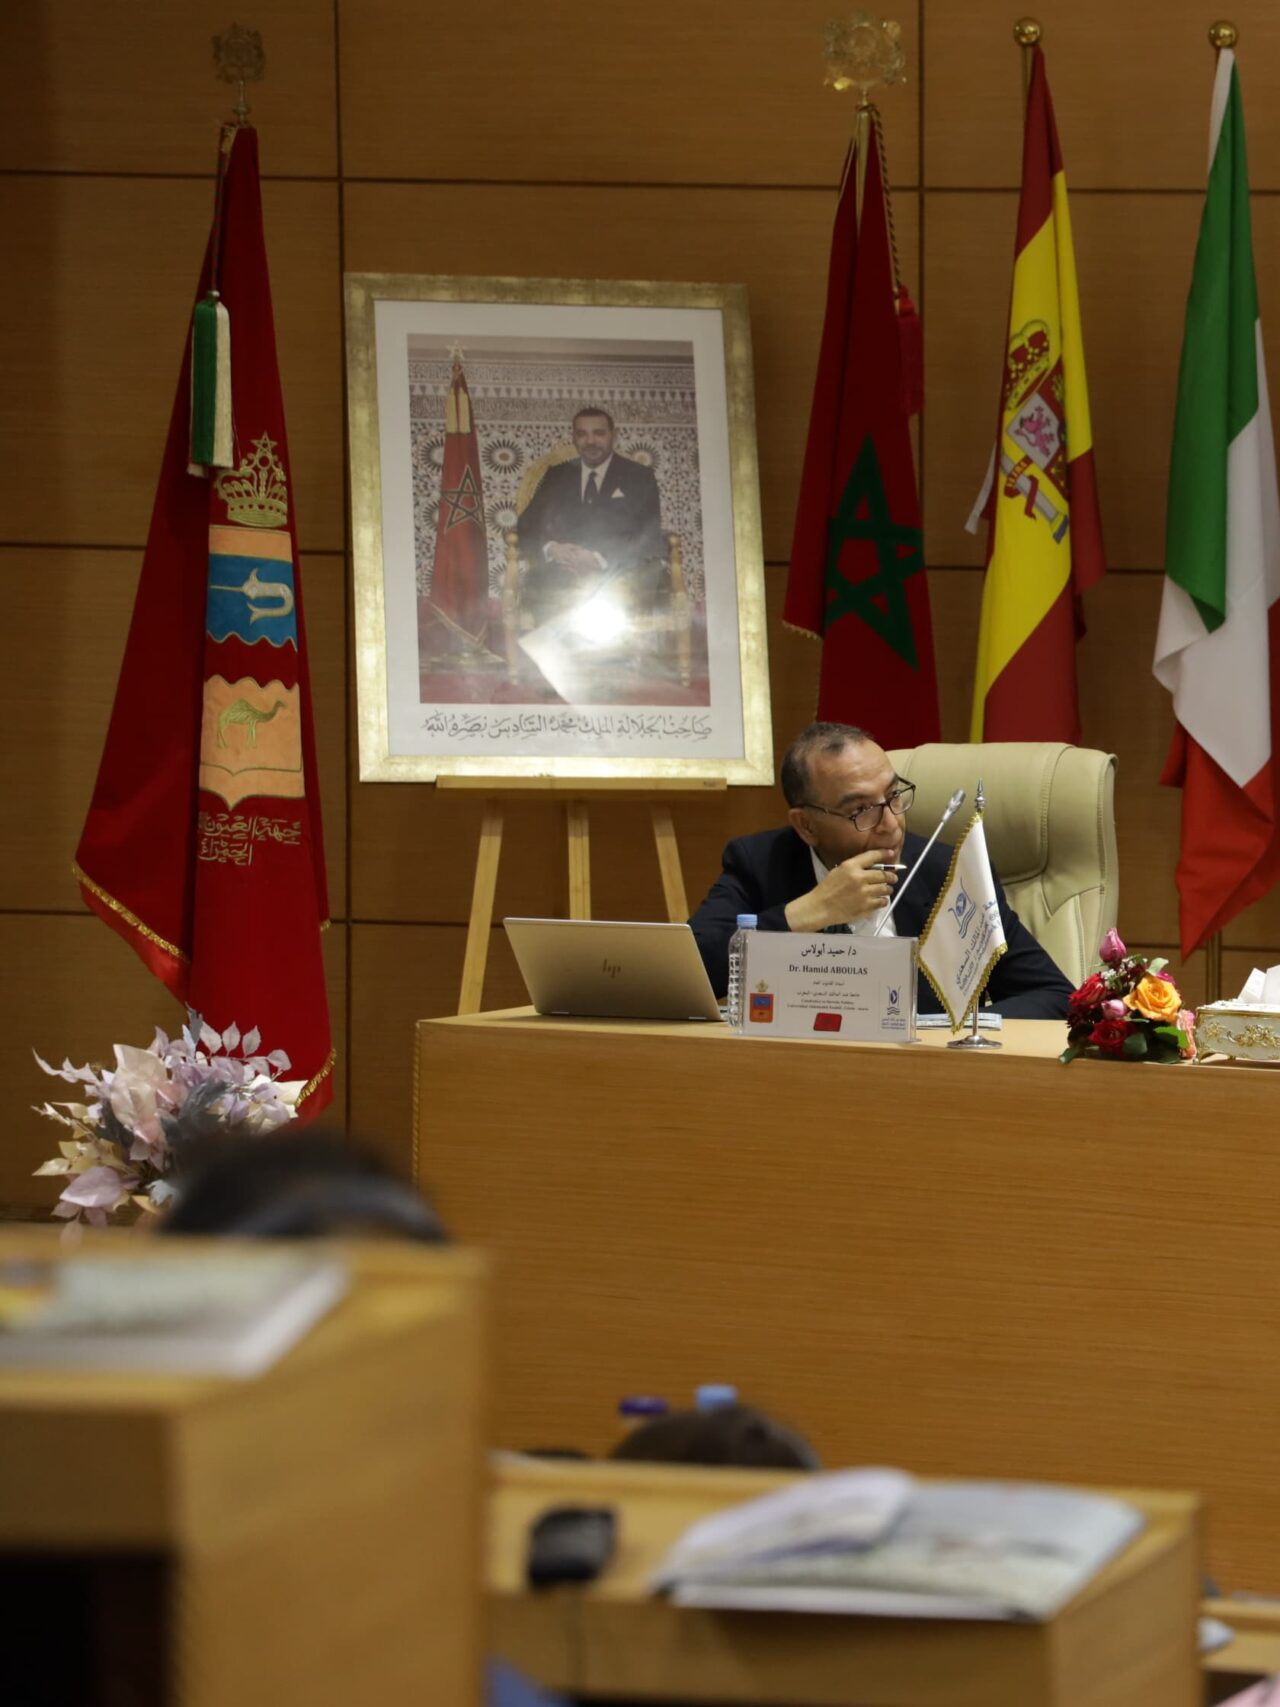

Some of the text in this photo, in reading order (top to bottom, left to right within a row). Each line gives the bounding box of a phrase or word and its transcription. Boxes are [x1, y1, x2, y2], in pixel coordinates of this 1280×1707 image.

[801, 943, 826, 957] أبولاس
[827, 947, 845, 957] حميد
[788, 964, 868, 976] Dr. Hamid ABOULAS
